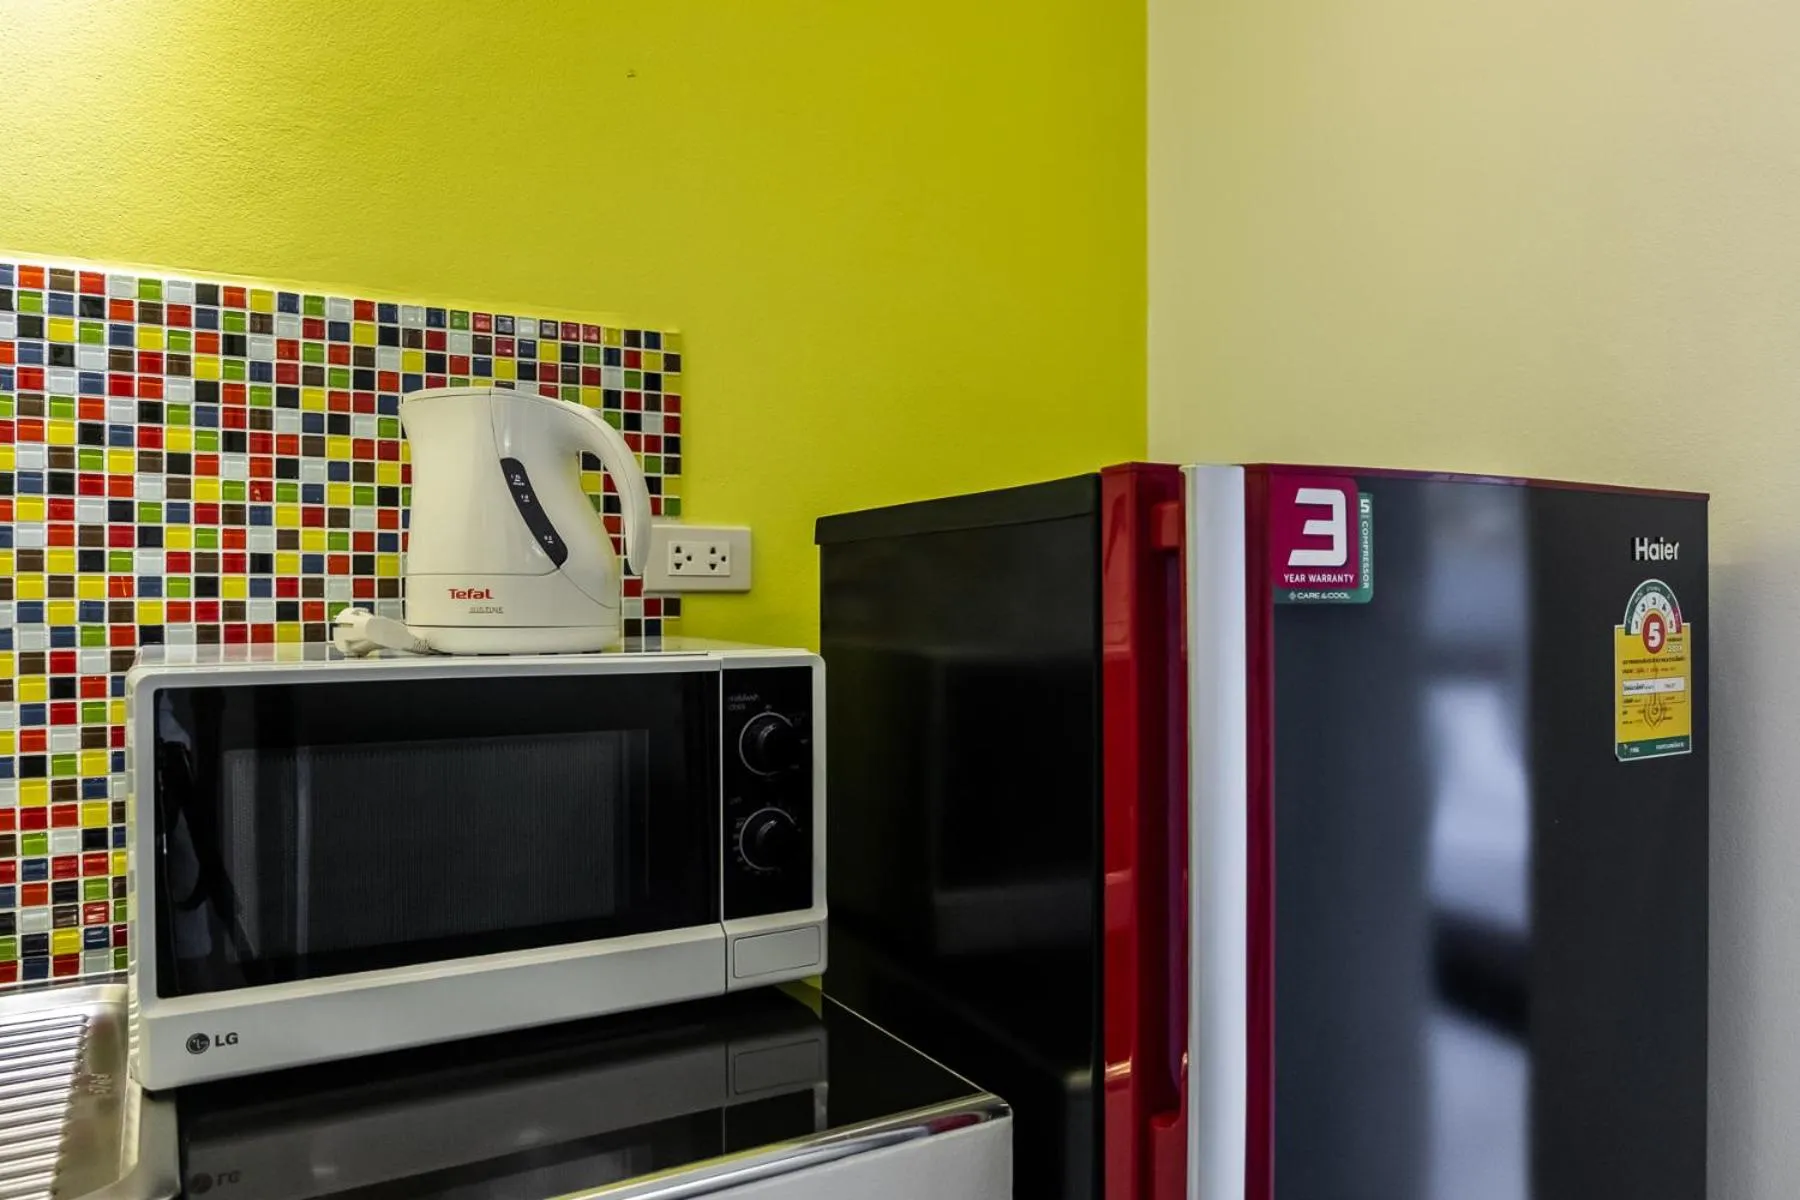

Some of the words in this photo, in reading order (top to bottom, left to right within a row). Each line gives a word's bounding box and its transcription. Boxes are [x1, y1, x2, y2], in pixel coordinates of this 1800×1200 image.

[1360, 498, 1370, 513] 5
[1288, 488, 1347, 566] 3
[1361, 520, 1369, 589] COMPRESSOR
[1634, 537, 1680, 561] Haier
[1284, 574, 1305, 583] YEAR
[1308, 574, 1354, 583] WARRANTY
[448, 588, 495, 600] Tefal
[1648, 622, 1661, 648] 5
[215, 1032, 239, 1047] LG
